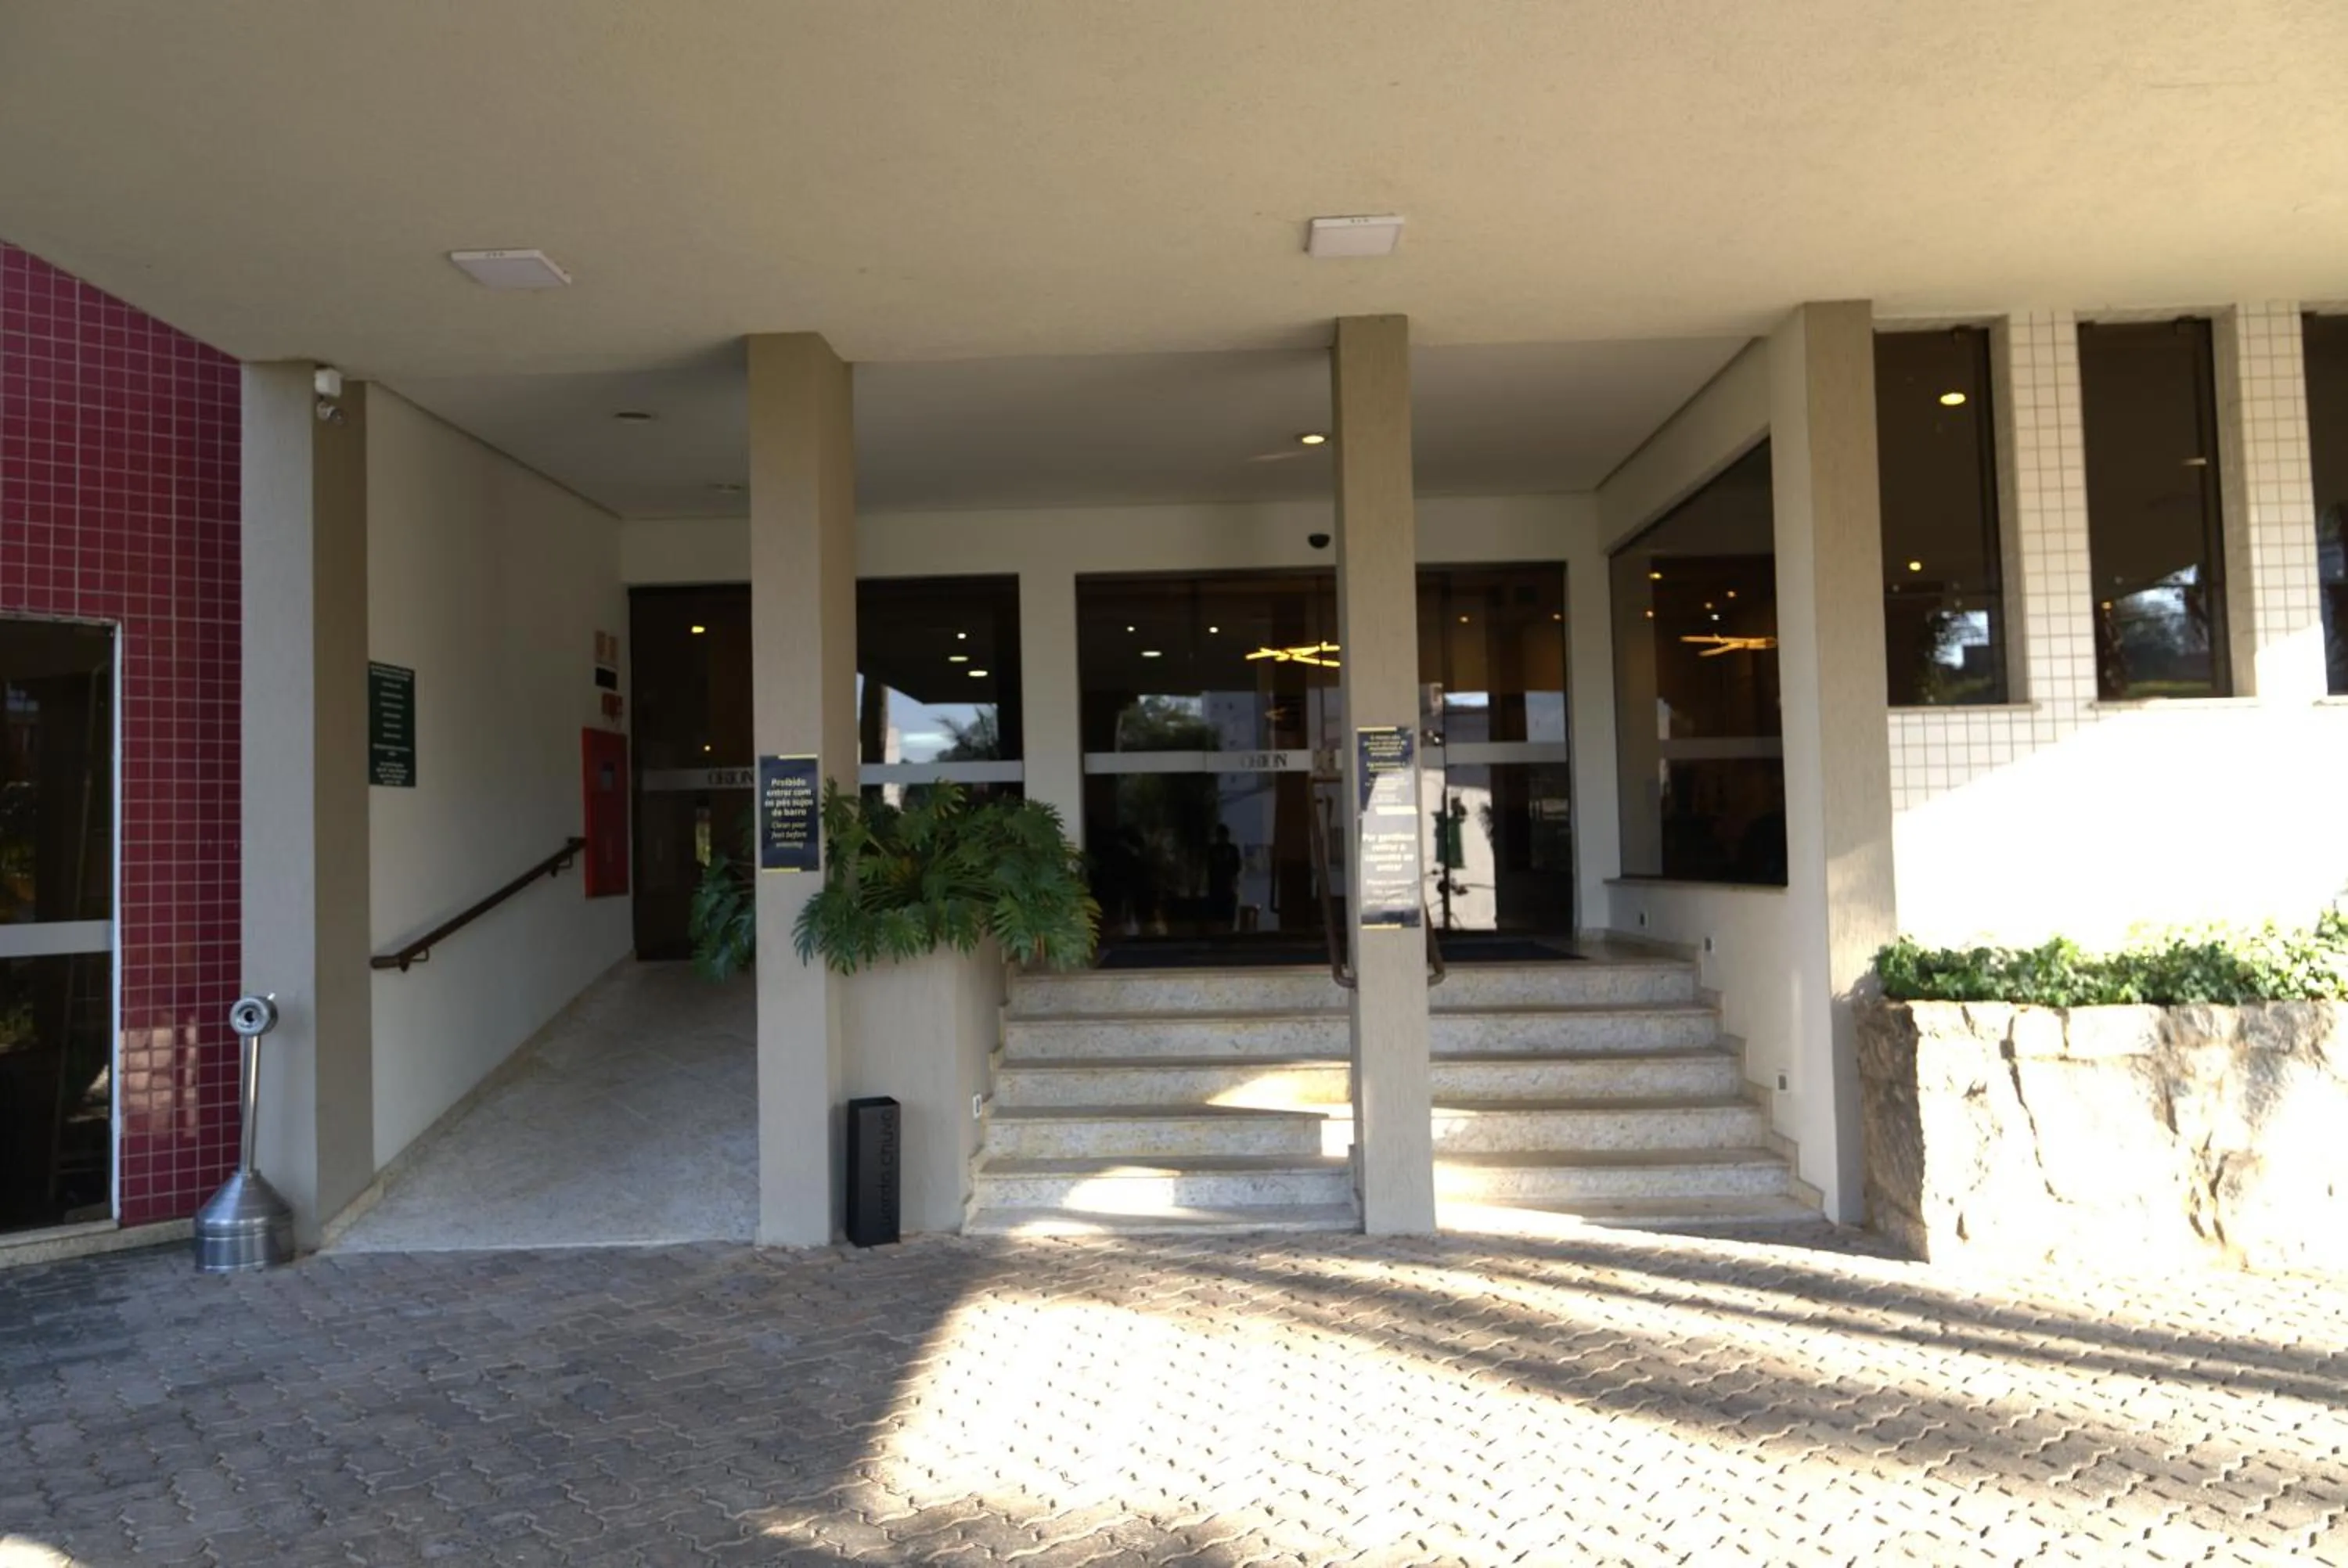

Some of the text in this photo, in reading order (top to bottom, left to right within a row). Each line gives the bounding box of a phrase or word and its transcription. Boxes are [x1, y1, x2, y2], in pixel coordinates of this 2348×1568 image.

[771, 778, 806, 786] Proibido
[766, 788, 812, 797] entrar com
